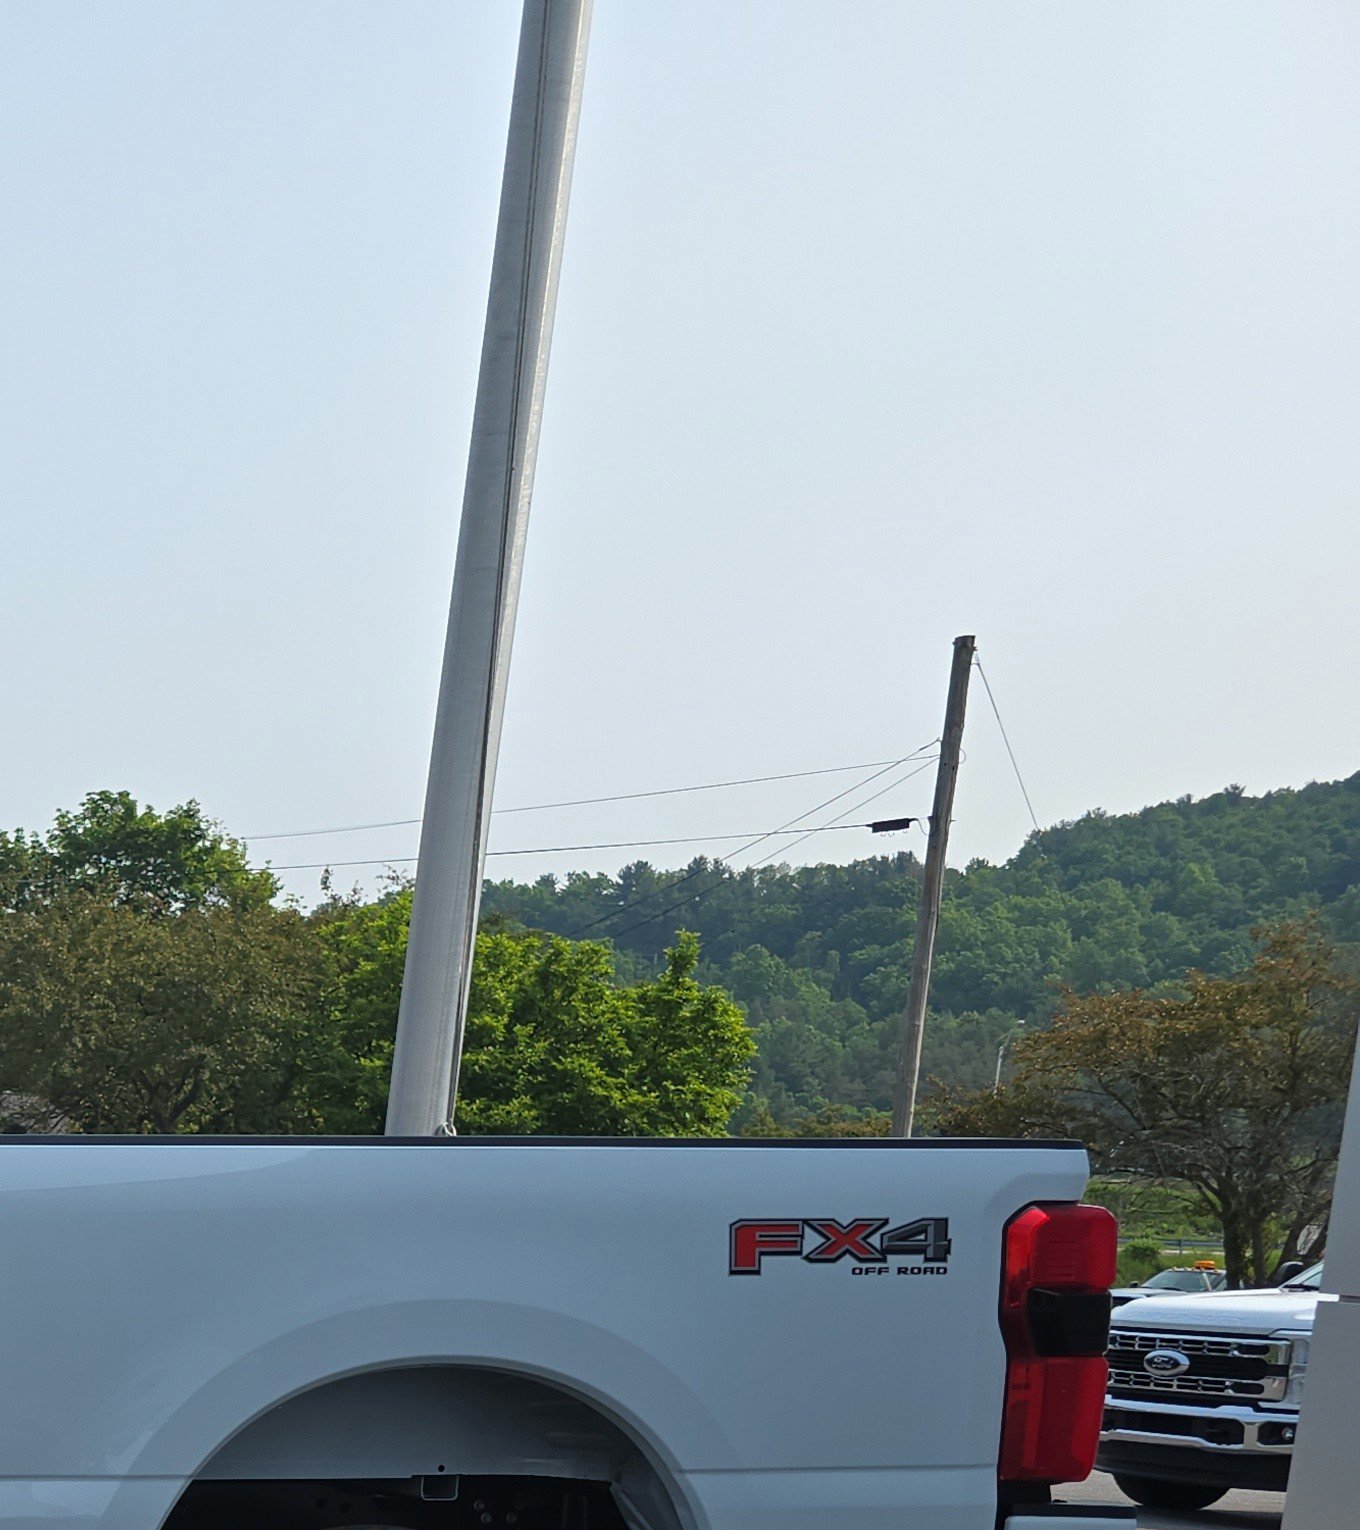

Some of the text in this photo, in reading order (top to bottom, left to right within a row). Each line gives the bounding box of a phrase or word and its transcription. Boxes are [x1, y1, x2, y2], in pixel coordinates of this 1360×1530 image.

[728, 1217, 951, 1276] FX4
[851, 1266, 948, 1276] OFF ROAD
